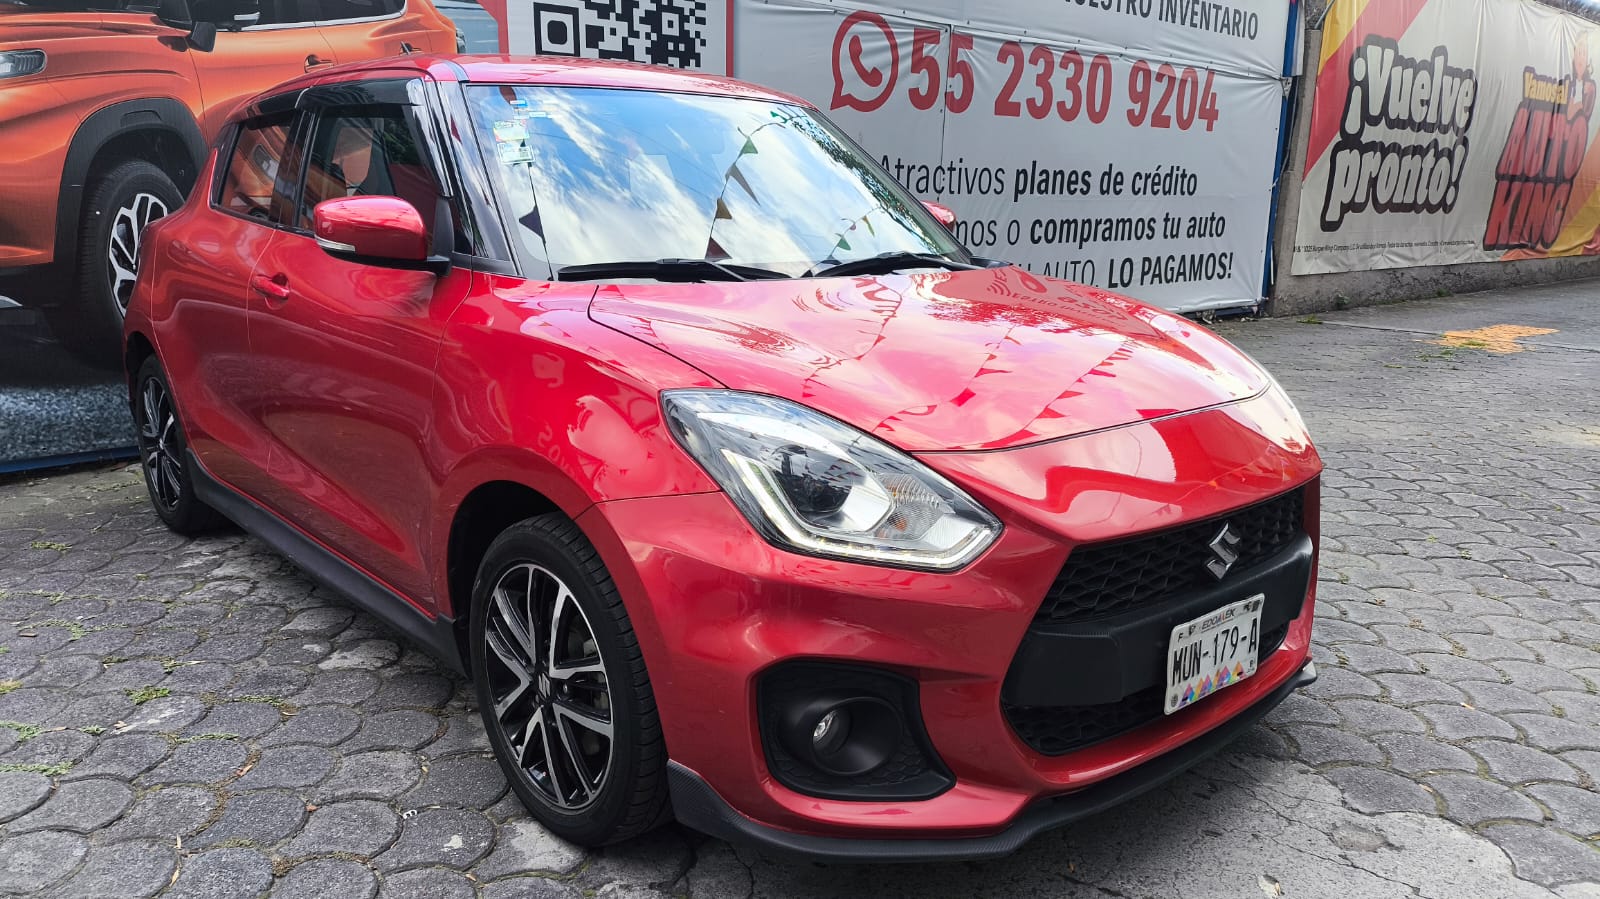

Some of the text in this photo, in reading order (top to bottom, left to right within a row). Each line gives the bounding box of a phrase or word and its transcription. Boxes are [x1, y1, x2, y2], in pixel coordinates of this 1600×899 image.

[1158, 0, 1258, 40] INVENTARIO
[908, 27, 1219, 132] 55 2330 9204
[1343, 42, 1475, 136] ¡Vuelve
[1497, 107, 1588, 180] AUTO
[1013, 160, 1092, 202] planes
[1099, 163, 1124, 196] de
[1131, 164, 1199, 196] crédito
[1324, 142, 1467, 223] pronto!
[1485, 181, 1571, 244] KING
[1007, 219, 1020, 246] o
[1030, 216, 1157, 249] compramos
[1163, 211, 1182, 240] tu
[1186, 212, 1226, 239] auto
[1108, 257, 1134, 289] LO
[1140, 252, 1234, 286] PAGAMOS!
[1172, 617, 1258, 686] MUN-179-A
